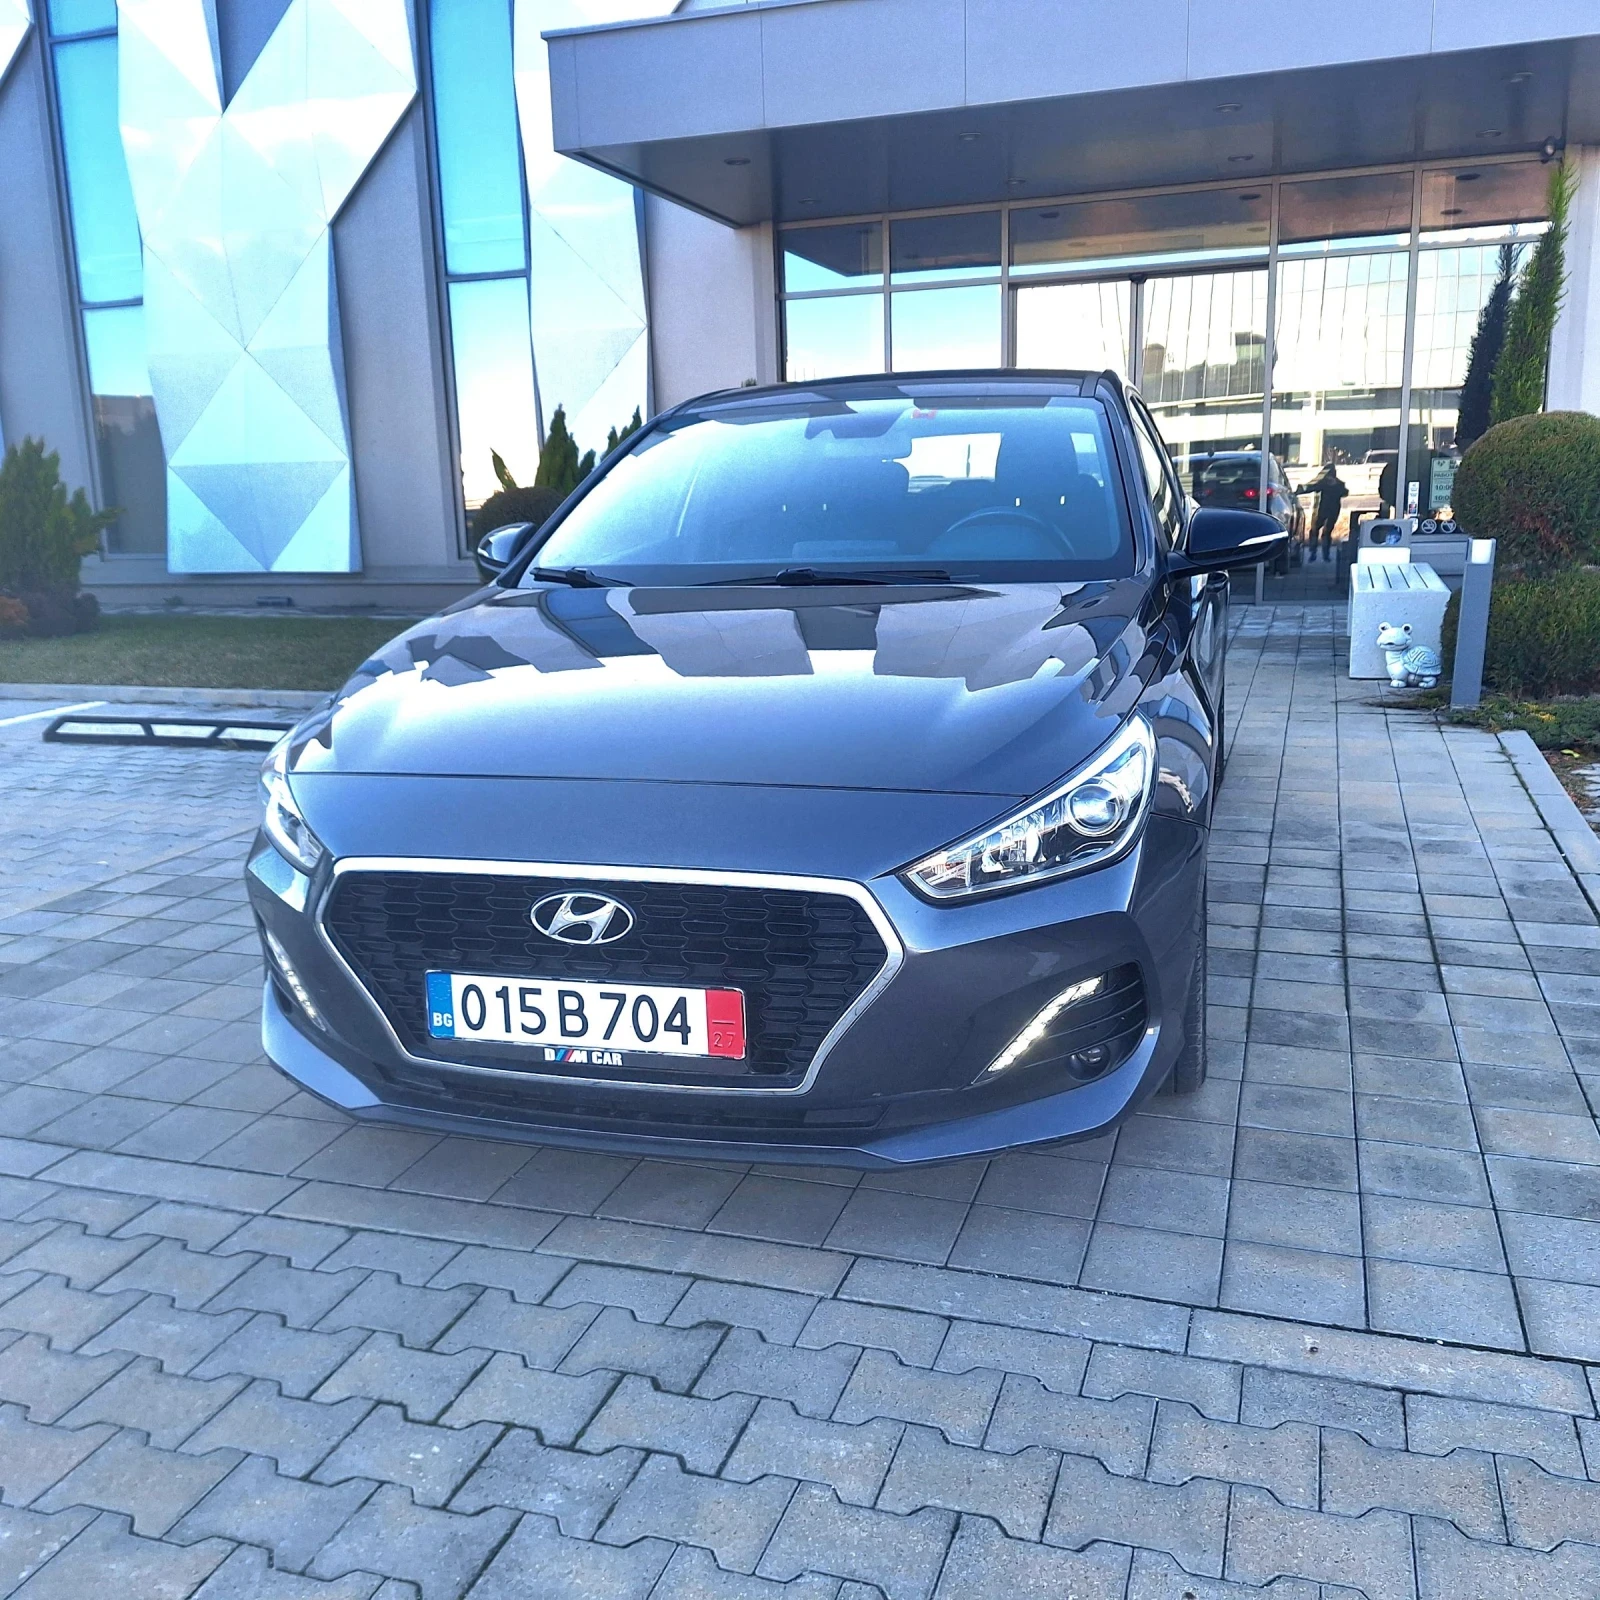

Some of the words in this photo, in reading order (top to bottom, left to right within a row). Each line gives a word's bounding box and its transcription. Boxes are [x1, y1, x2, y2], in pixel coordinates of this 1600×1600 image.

[432, 1012, 453, 1027] BG
[713, 1032, 736, 1048] 27
[591, 1051, 623, 1066] CAR
